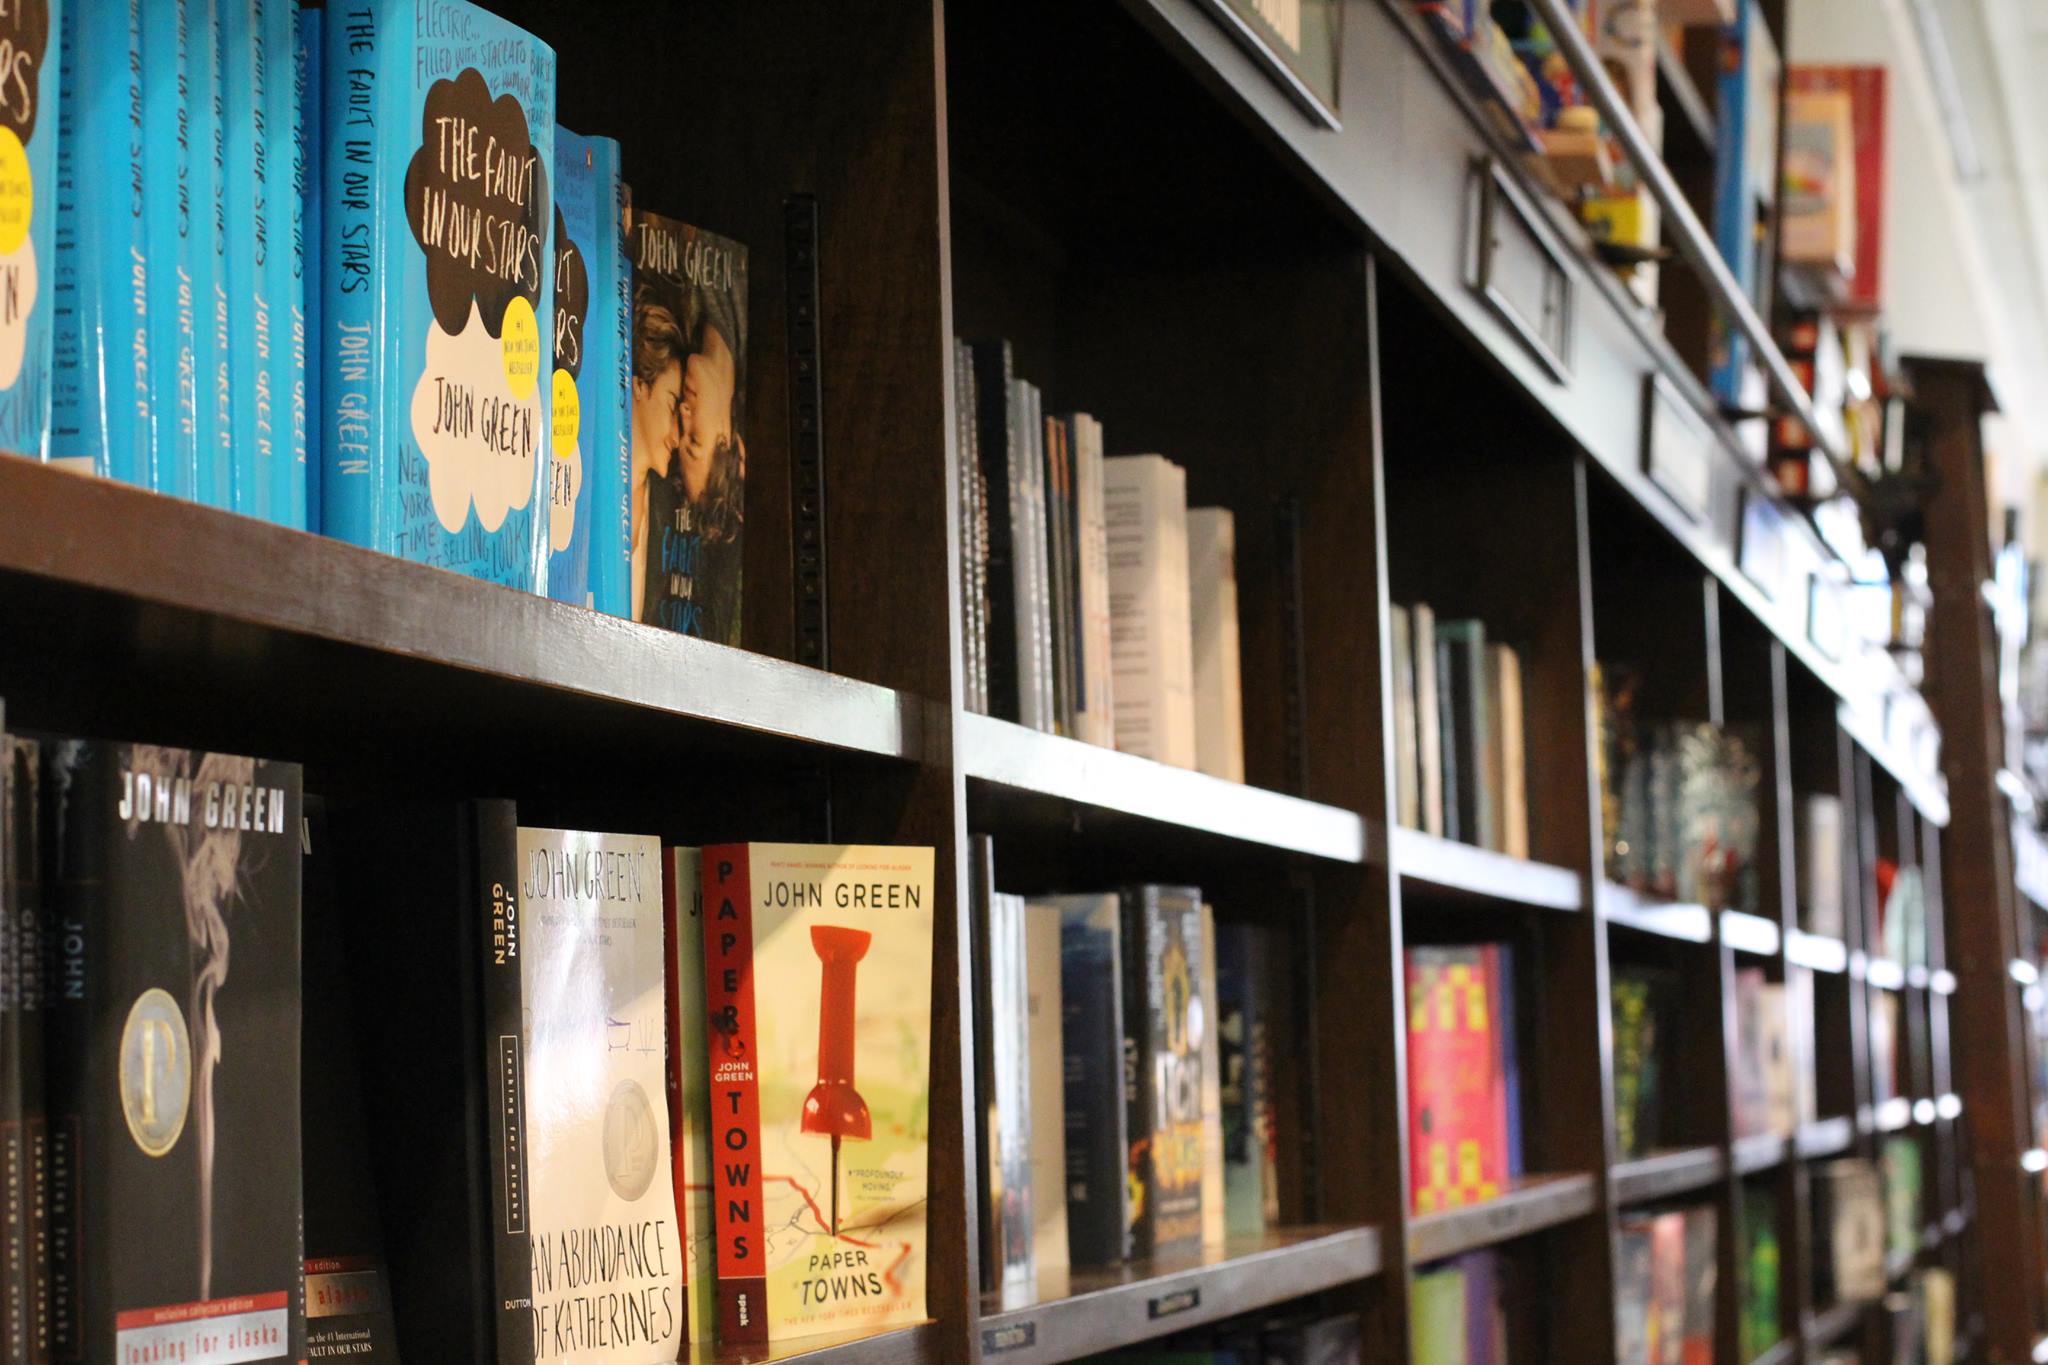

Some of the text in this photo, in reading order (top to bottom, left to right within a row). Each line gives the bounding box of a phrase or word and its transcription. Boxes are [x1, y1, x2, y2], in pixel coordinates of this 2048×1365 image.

[417, 46, 452, 89] FILLED
[455, 46, 477, 69] WITH
[481, 38, 526, 69] STACCATO
[502, 69, 532, 102] HUMOR
[436, 117, 481, 183] THE
[485, 135, 536, 217] FAULT
[338, 7, 375, 476] THE FAULT IN OUR STARS JOHN GREEN
[422, 186, 446, 249] IN
[448, 201, 482, 270] OUR
[485, 215, 540, 293] STARS
[637, 222, 733, 293] JOHN GREEN
[255, 292, 271, 359] JOHN
[256, 370, 272, 457] GREEN
[431, 376, 531, 458] JOHN GREEN
[399, 445, 427, 487] NEW
[399, 492, 431, 526] YORK
[675, 507, 692, 533] THE
[396, 521, 439, 558] TIME
[119, 771, 285, 835] JOHN GREEN
[525, 848, 578, 901] JOHN
[584, 850, 641, 903] GREEN
[764, 882, 921, 909] JOHN GREEN
[492, 883, 505, 964] GREEN
[506, 891, 516, 957] JOHN
[717, 860, 740, 1036] PAPER
[65, 921, 84, 1000] JOHN
[715, 1071, 753, 1082] GREEN
[719, 1062, 749, 1072] JOHN
[724, 1091, 751, 1260] TOWNS
[314, 1260, 340, 1271] edition
[532, 1220, 669, 1295] AN ABUNDANCE
[809, 1250, 869, 1273] PAPER
[505, 1298, 531, 1310] DUTTON
[738, 1293, 750, 1327] speak
[802, 1272, 883, 1306] TOWNS
[125, 1323, 279, 1364] looking for alaska
[316, 1332, 326, 1343] the
[335, 1328, 371, 1341] International
[555, 1286, 672, 1357] KATHERINES
[327, 1344, 336, 1355] IN
[336, 1343, 351, 1355] OUR
[352, 1342, 373, 1353] STARS
